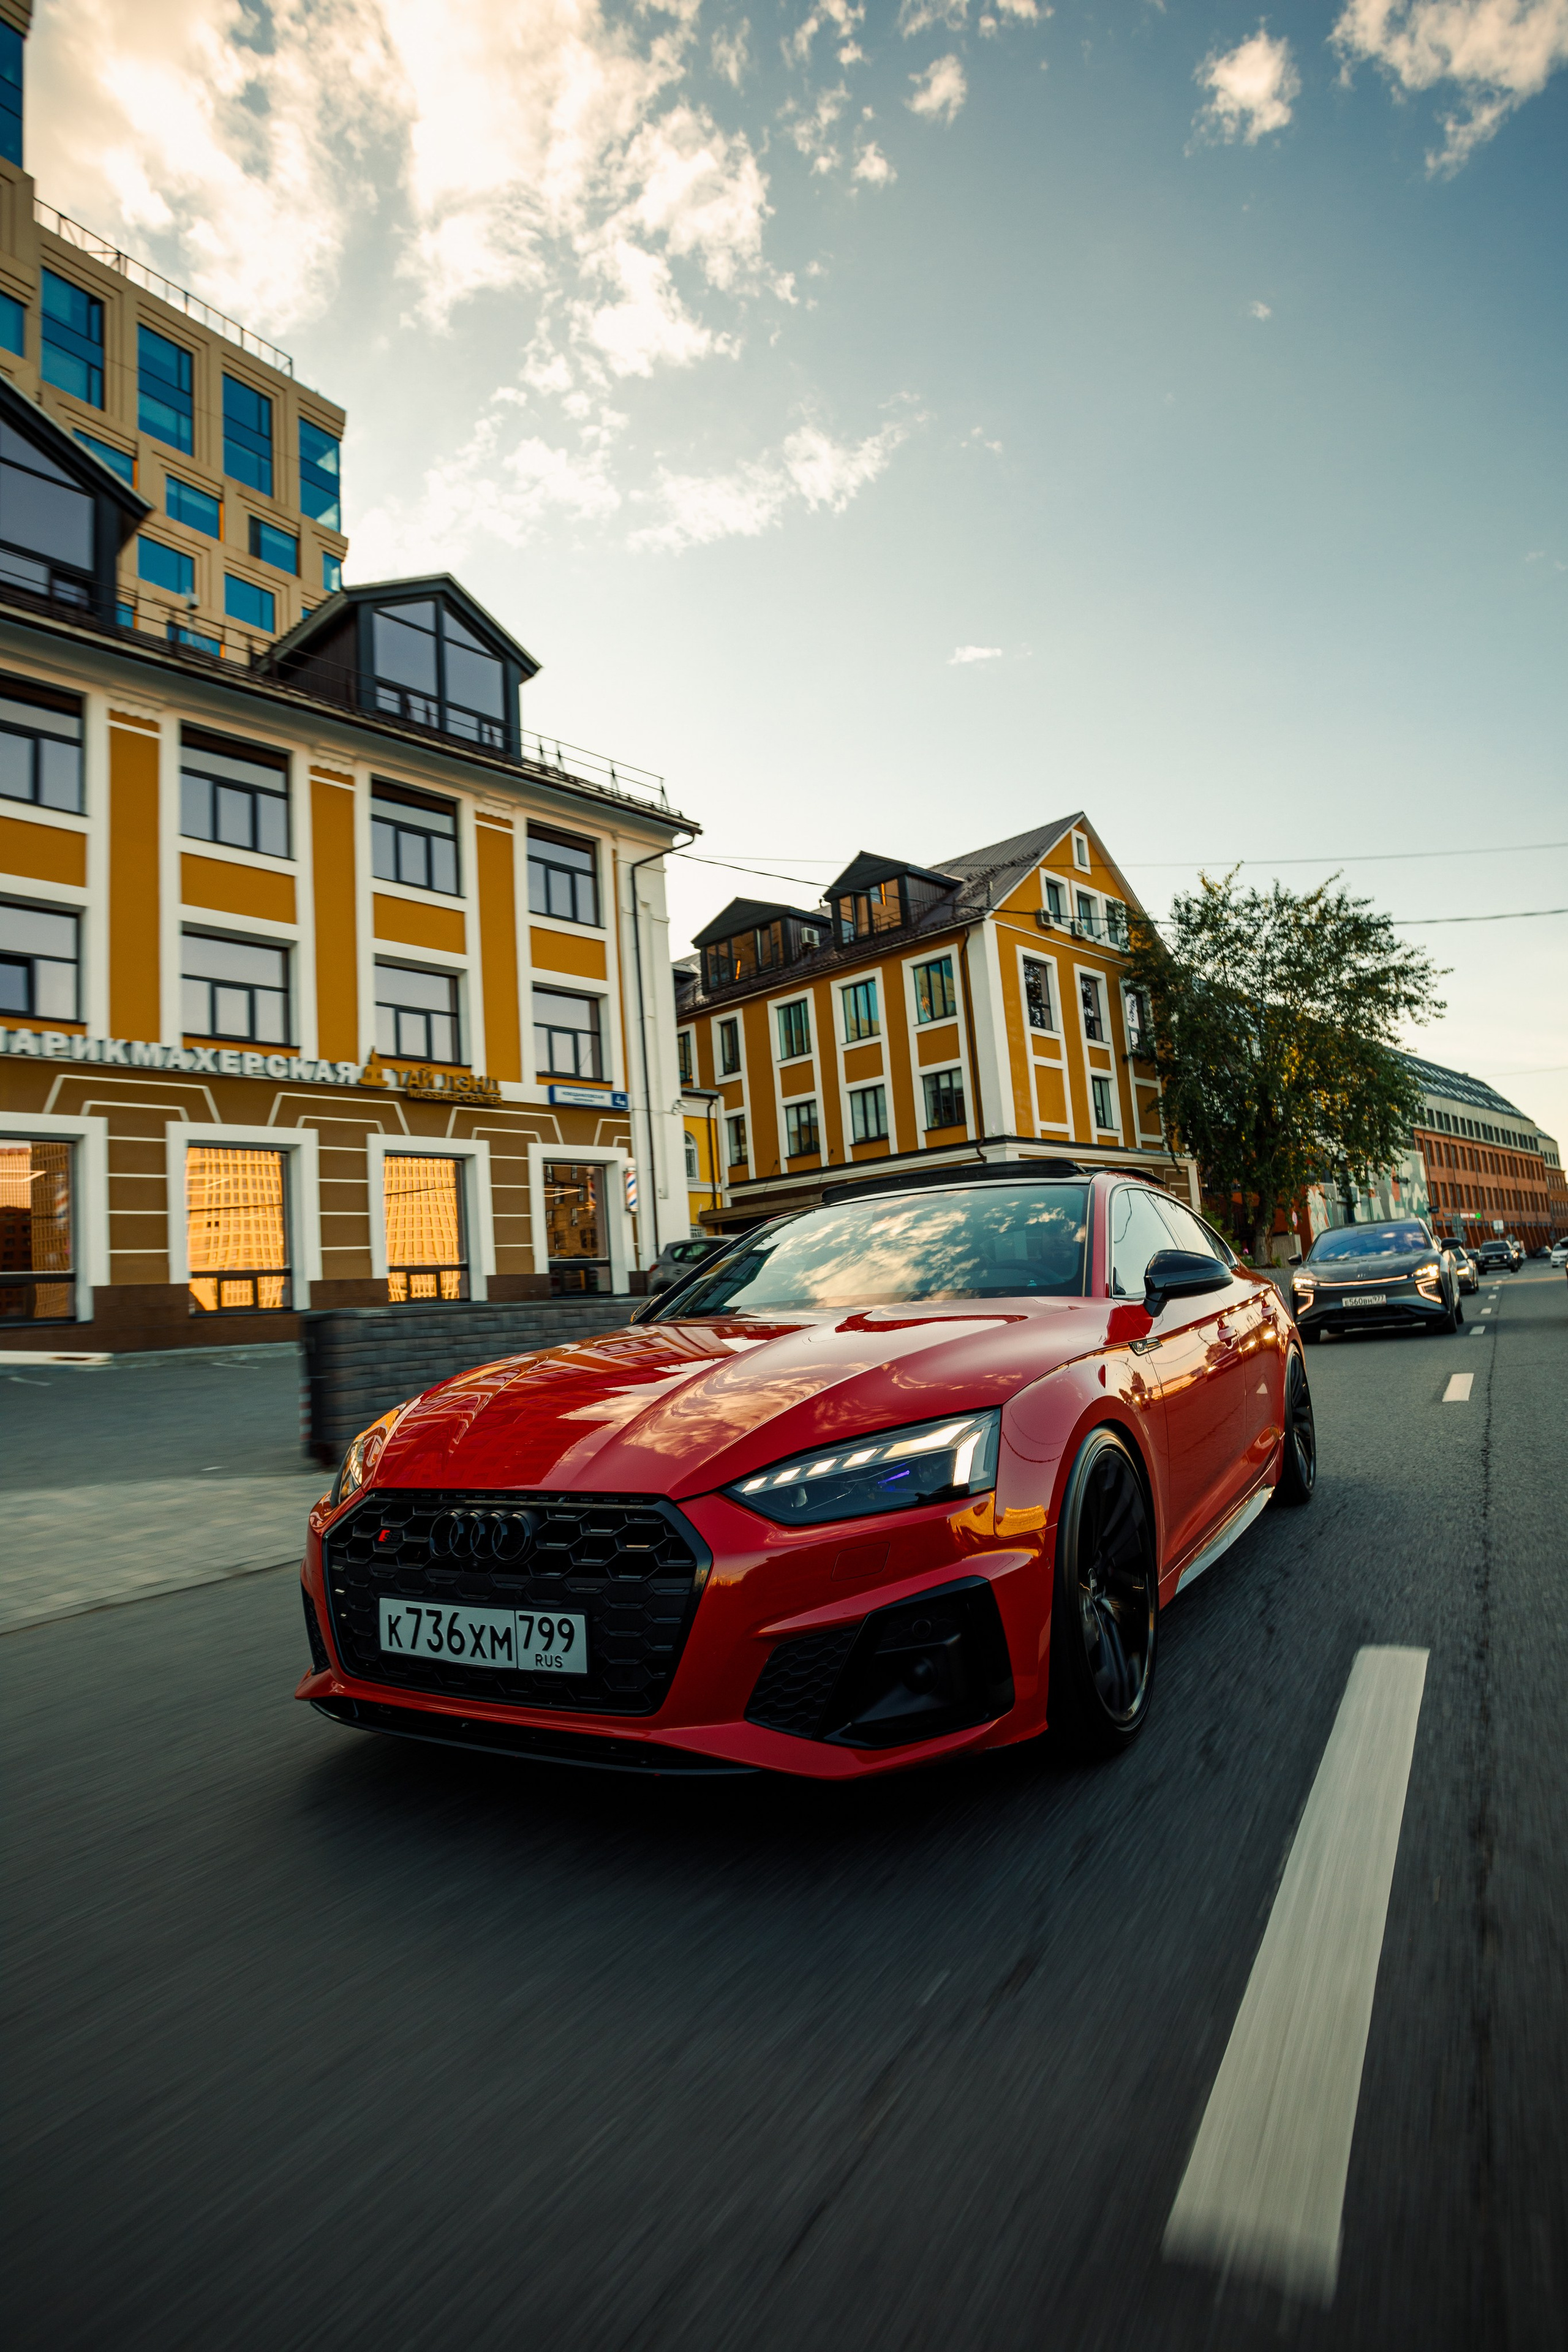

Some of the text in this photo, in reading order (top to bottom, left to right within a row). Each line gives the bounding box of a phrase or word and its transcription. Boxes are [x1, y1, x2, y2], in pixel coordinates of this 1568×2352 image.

[388, 1607, 575, 1661] К736ХМ 799
[535, 1653, 563, 1668] RUS
